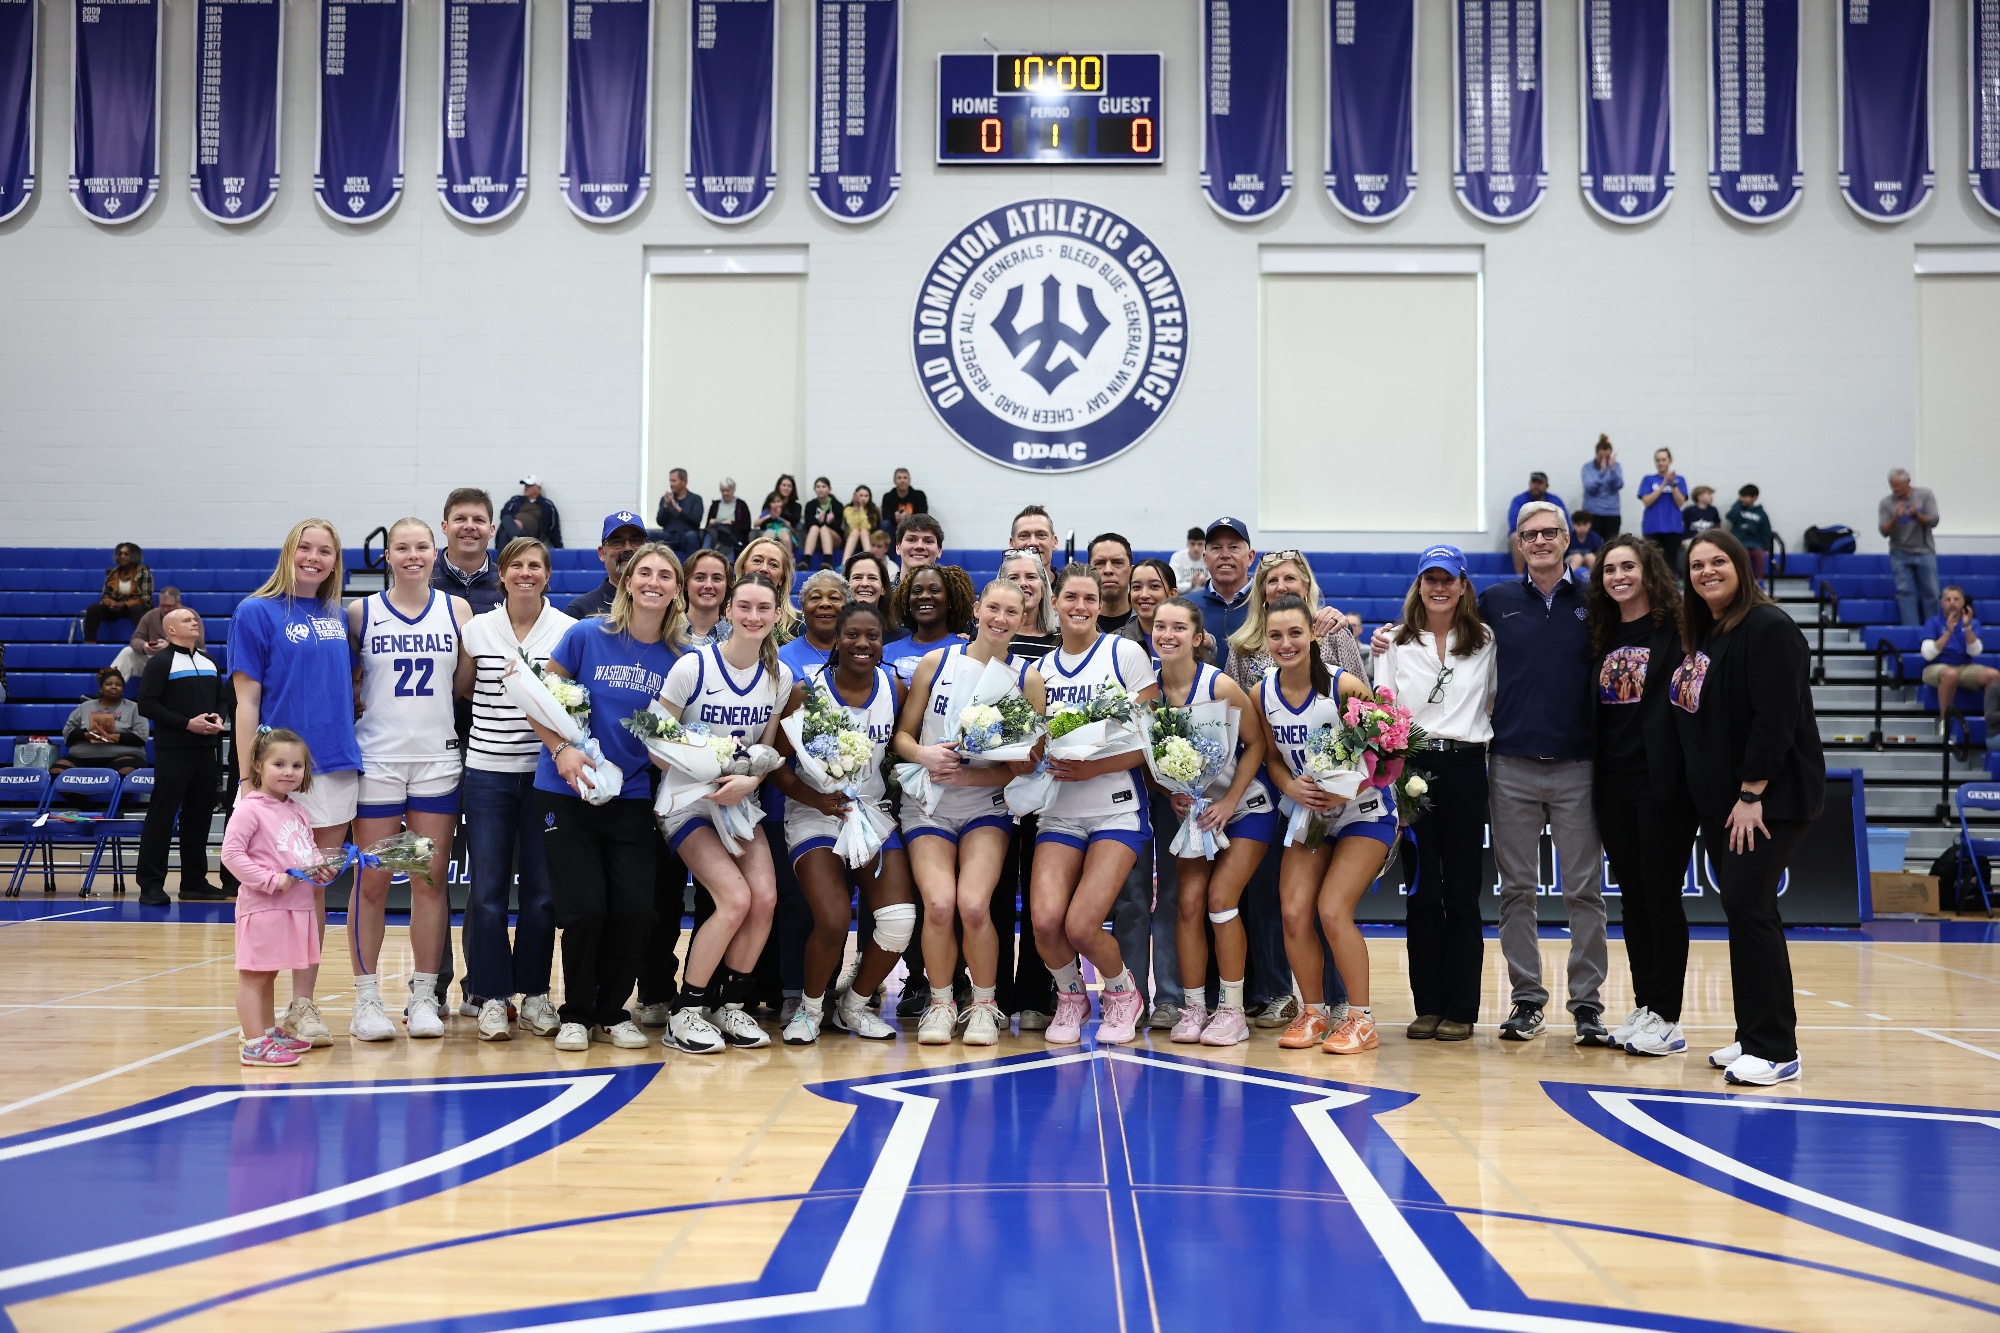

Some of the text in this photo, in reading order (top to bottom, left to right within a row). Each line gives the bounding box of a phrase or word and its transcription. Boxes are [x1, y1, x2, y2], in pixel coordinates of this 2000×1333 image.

[451, 6, 468, 14] 1972
[205, 24, 221, 32] 1972
[205, 41, 220, 49] 1977
[327, 67, 343, 75] 2024
[1013, 55, 1101, 91] 10:00
[952, 97, 998, 114] HOME
[1030, 106, 1070, 119] PERIOD
[1098, 97, 1151, 114] GUEST
[981, 118, 1002, 153] 0
[1051, 123, 1059, 147] 1
[1131, 118, 1152, 153] 0
[84, 177, 143, 186] WOMEN'S INDOOR
[223, 177, 245, 185] MEN'S
[346, 176, 368, 185] MEN'S
[470, 176, 492, 185] MEN'S
[837, 176, 872, 184] WOMEN'S
[1234, 174, 1258, 183] MEN'S
[88, 185, 138, 194] TRACK & FIELD
[225, 185, 243, 193] GOLF
[343, 184, 370, 193] SOCCER
[453, 184, 509, 193] CROSS COUNTRY
[580, 183, 629, 193] FIELD HOCKEY
[970, 244, 1044, 300] GO GENERALS
[1060, 245, 1127, 293] BLEED BLUE
[919, 203, 1183, 412] OLD DOMINION ATHLETIC CONFERENCE
[959, 310, 992, 393] RESPECT ALL
[1087, 300, 1142, 414] GENERALS WIN DAY
[994, 394, 1074, 424] CHEER HARD
[1012, 441, 1087, 460] ODAC
[312, 620, 345, 630] STRIVE
[372, 634, 452, 654] GENERALS
[394, 658, 434, 697] 22
[594, 665, 662, 690] WASHINGTON AND
[609, 680, 659, 697] UNIVERSITY
[1046, 685, 1093, 706] ENERAL
[700, 703, 773, 726] GENERALS
[0, 775, 40, 784] ENERALS
[62, 775, 110, 784] GENERALS
